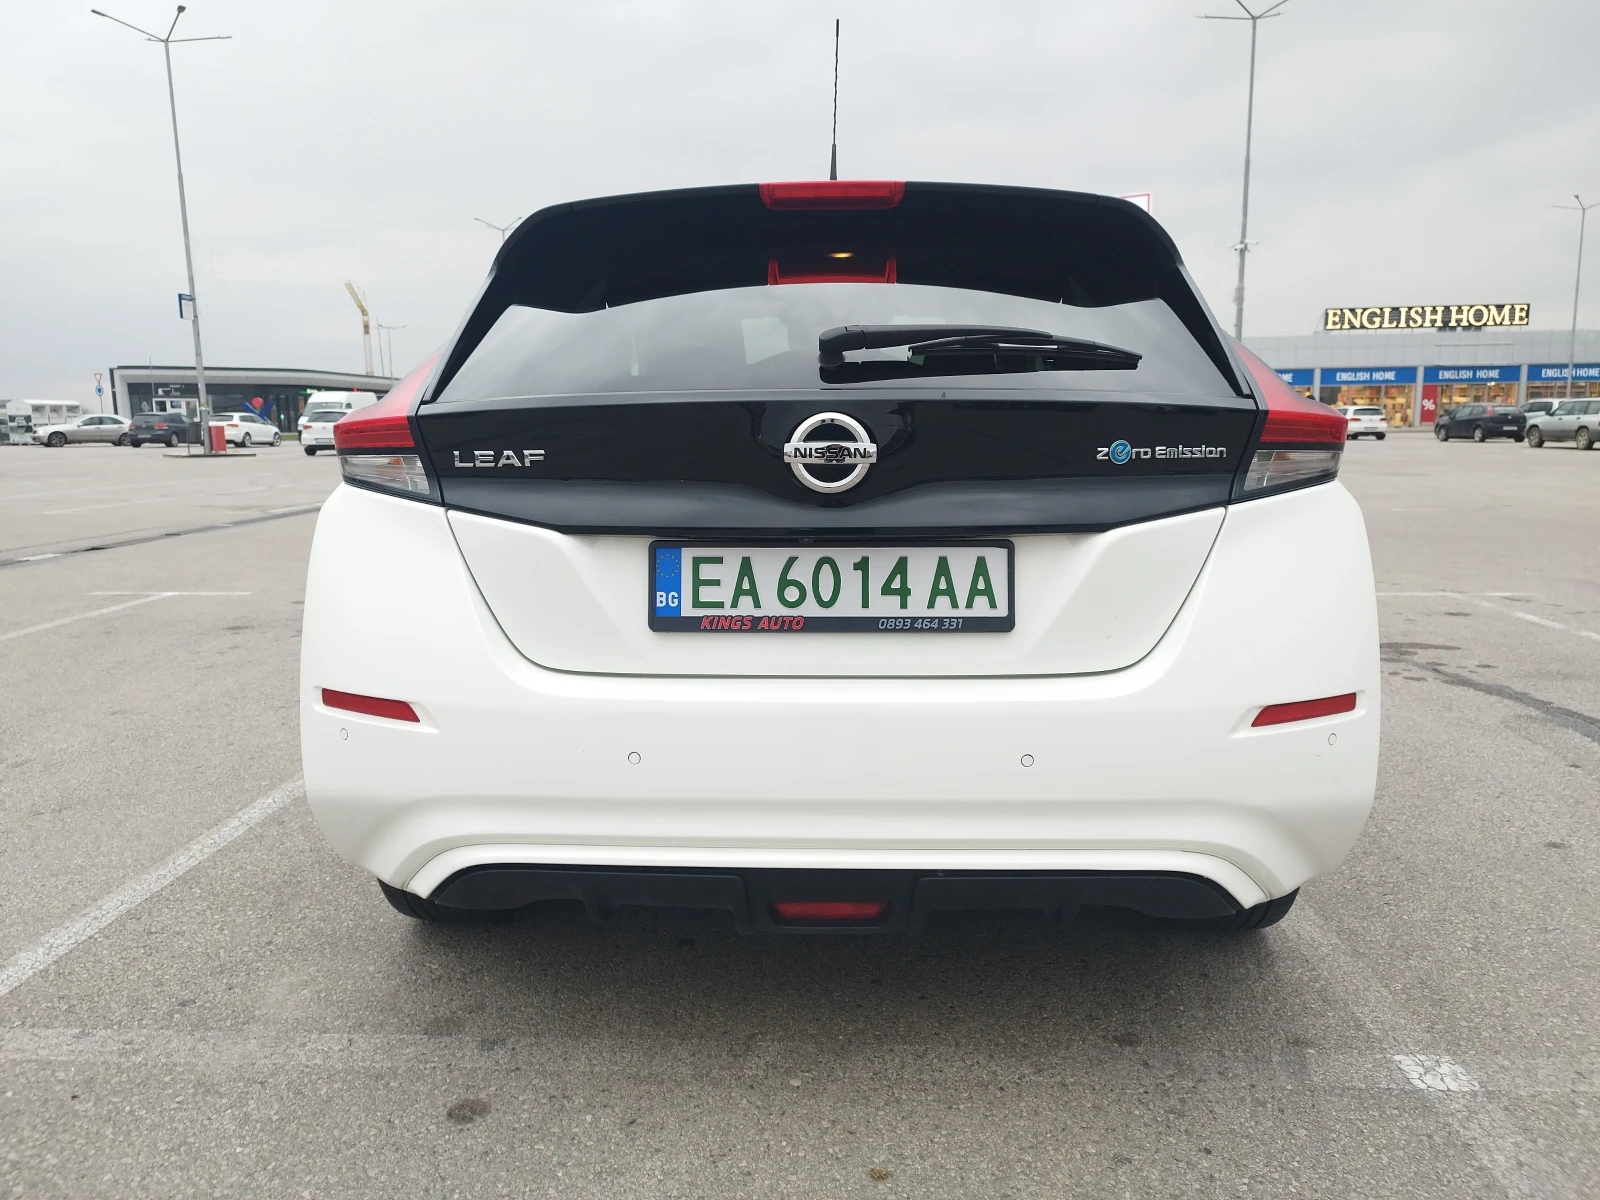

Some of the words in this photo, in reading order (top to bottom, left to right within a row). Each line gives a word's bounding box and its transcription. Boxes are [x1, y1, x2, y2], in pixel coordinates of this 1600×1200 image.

[1325, 307, 1444, 330] ENGLISH
[1449, 304, 1528, 326] HOME
[1336, 371, 1370, 382] ENGLISH
[1372, 371, 1396, 381] HOME
[1438, 370, 1473, 380] ENGLISH
[1476, 369, 1500, 379] HOME
[1576, 367, 1600, 378] HOME
[452, 449, 546, 468] LEAF
[793, 446, 867, 459] NISSAN
[1155, 445, 1227, 459] Emission
[691, 556, 762, 610] EA
[776, 556, 912, 610] 6014
[926, 556, 998, 610] AA
[656, 591, 679, 607] BG
[700, 616, 753, 630] KINGS
[757, 616, 805, 630] AUTO
[878, 618, 912, 630] 0893
[914, 618, 939, 630] 464
[941, 618, 964, 630] 331
